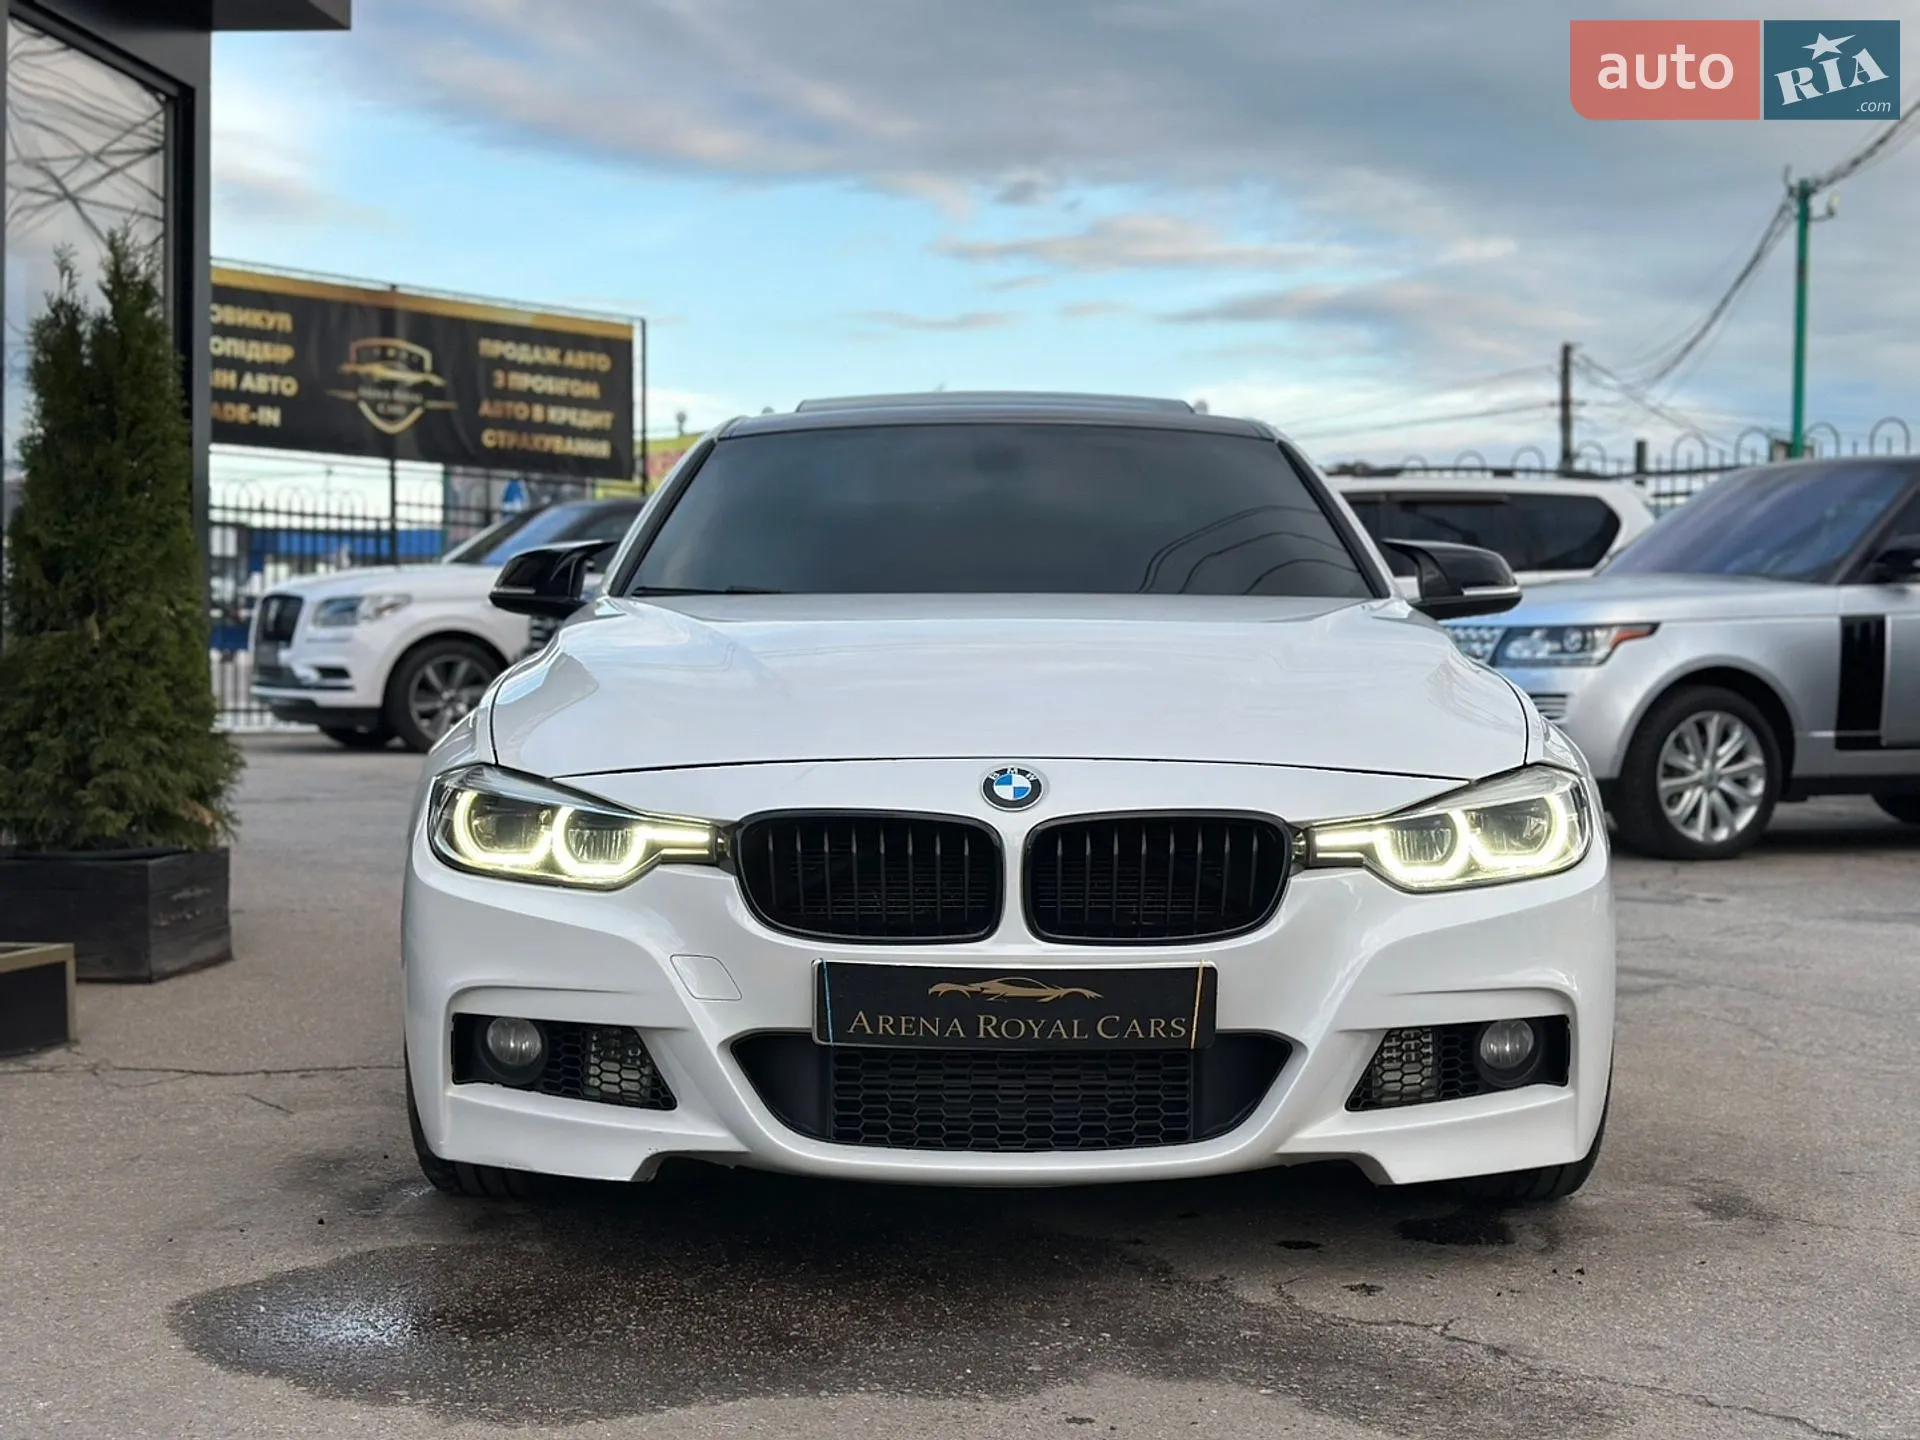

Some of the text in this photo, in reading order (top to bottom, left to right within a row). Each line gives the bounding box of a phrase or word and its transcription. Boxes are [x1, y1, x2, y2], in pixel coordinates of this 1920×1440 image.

[478, 337, 612, 372] ПРОДАЖ АВТО
[240, 370, 299, 397] АВТО
[507, 370, 601, 399] ПРОБІГОМ
[478, 399, 614, 431] АВТО В КРЕДИТ
[481, 427, 612, 460] СТРАХУВАННЯ
[988, 766, 1039, 781] BMW
[847, 1010, 1187, 1040] ARENA ROYAL CARS
